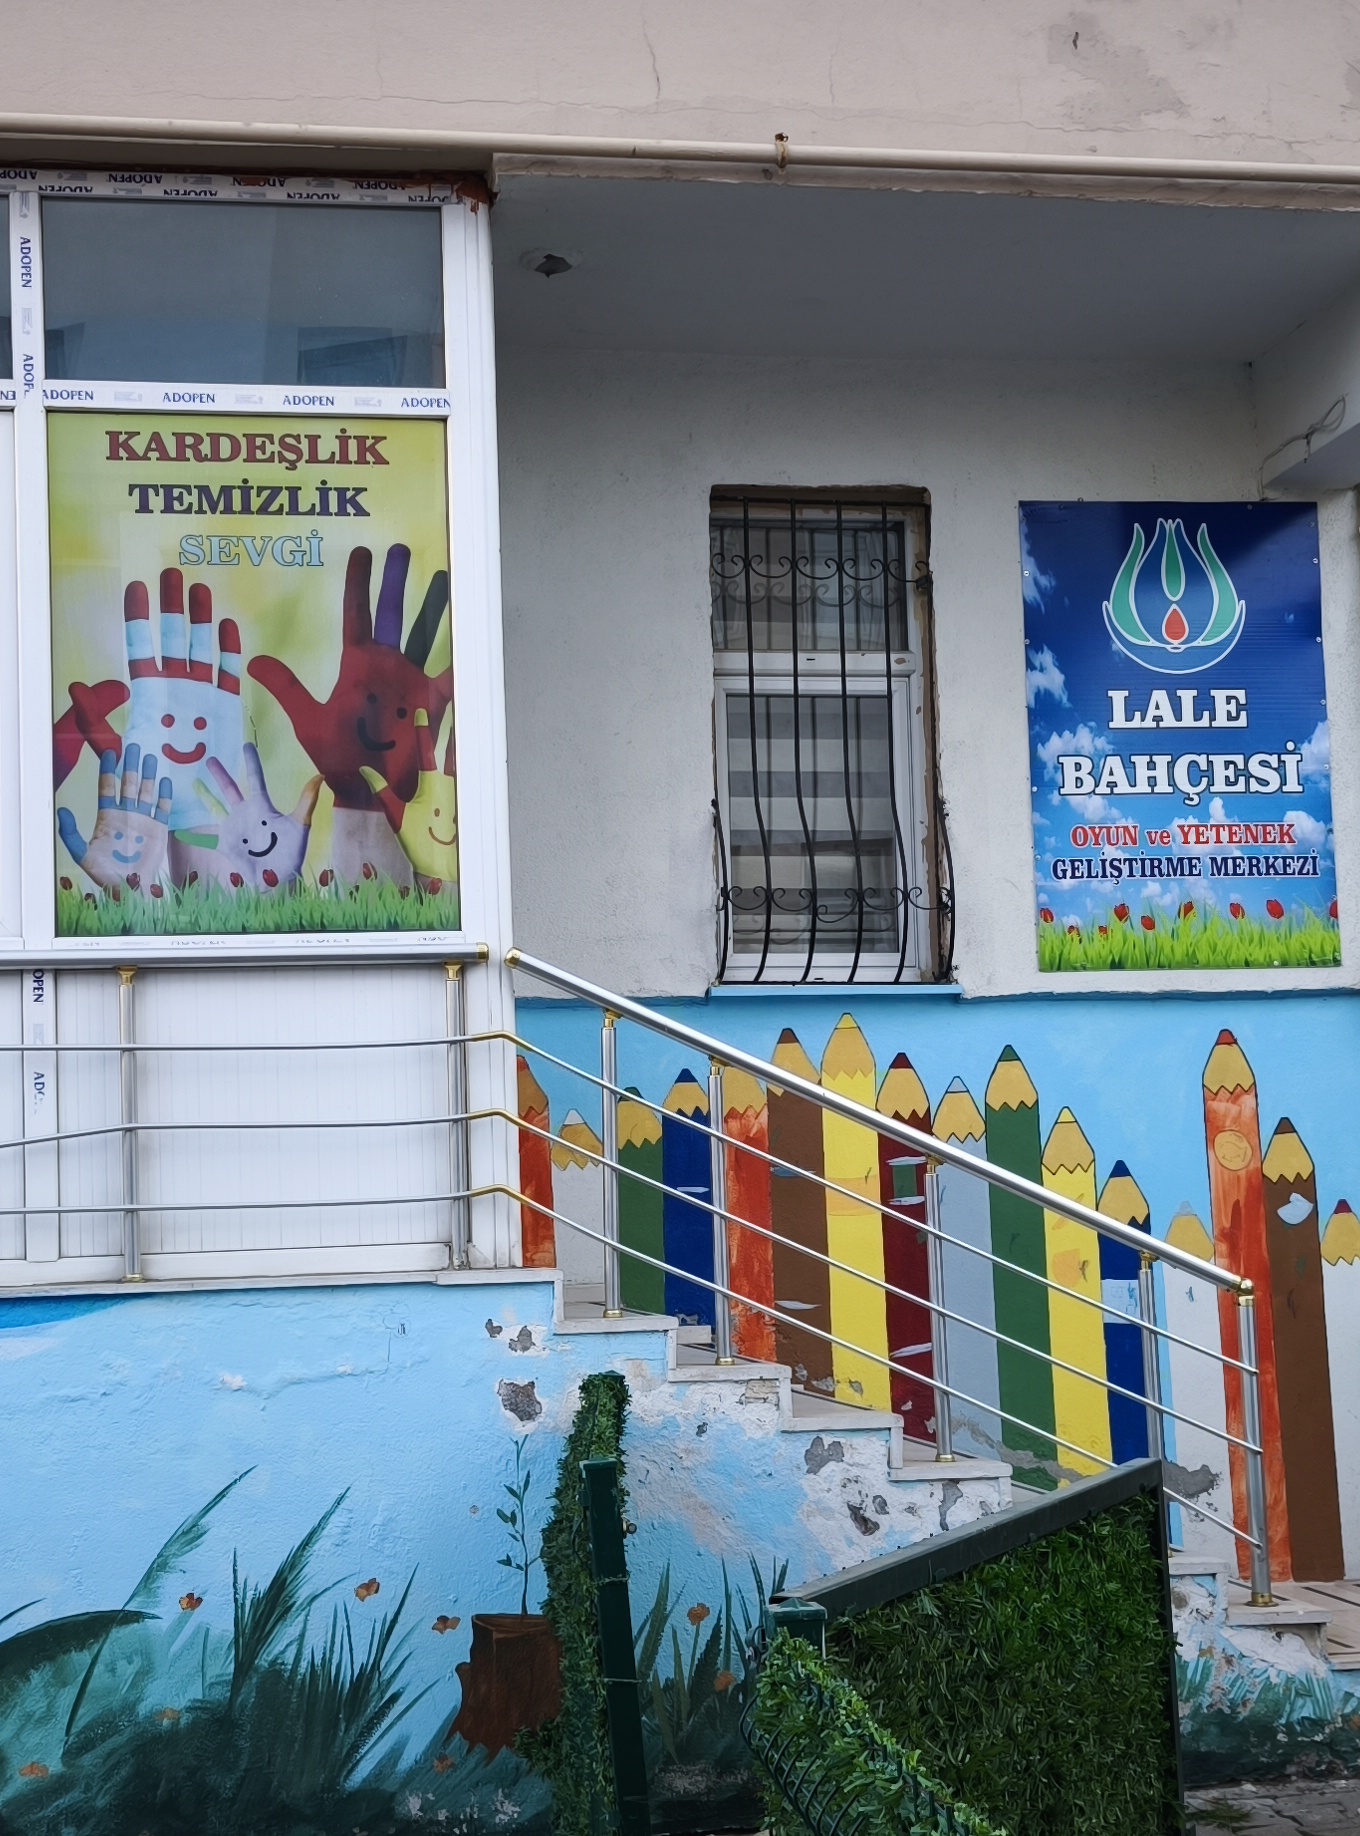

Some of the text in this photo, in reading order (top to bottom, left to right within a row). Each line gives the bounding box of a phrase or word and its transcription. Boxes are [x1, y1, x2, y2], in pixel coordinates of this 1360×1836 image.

[108, 172, 163, 185] ADOPEN
[19, 236, 33, 288] ADOPEN
[41, 388, 451, 409] ADOPEN ADOPEN ADOPEN ADOPEN
[105, 428, 390, 471] KARDEŞLİK
[128, 478, 371, 517] TEMİZLİK
[178, 529, 324, 567] SEVGİ
[1107, 688, 1249, 730] LALE
[1057, 740, 1305, 806] BAHÇESİ
[1070, 823, 1297, 848] OYUN ve YETENEK
[1052, 848, 1320, 886] GELİŞTİRME MERKEZİ
